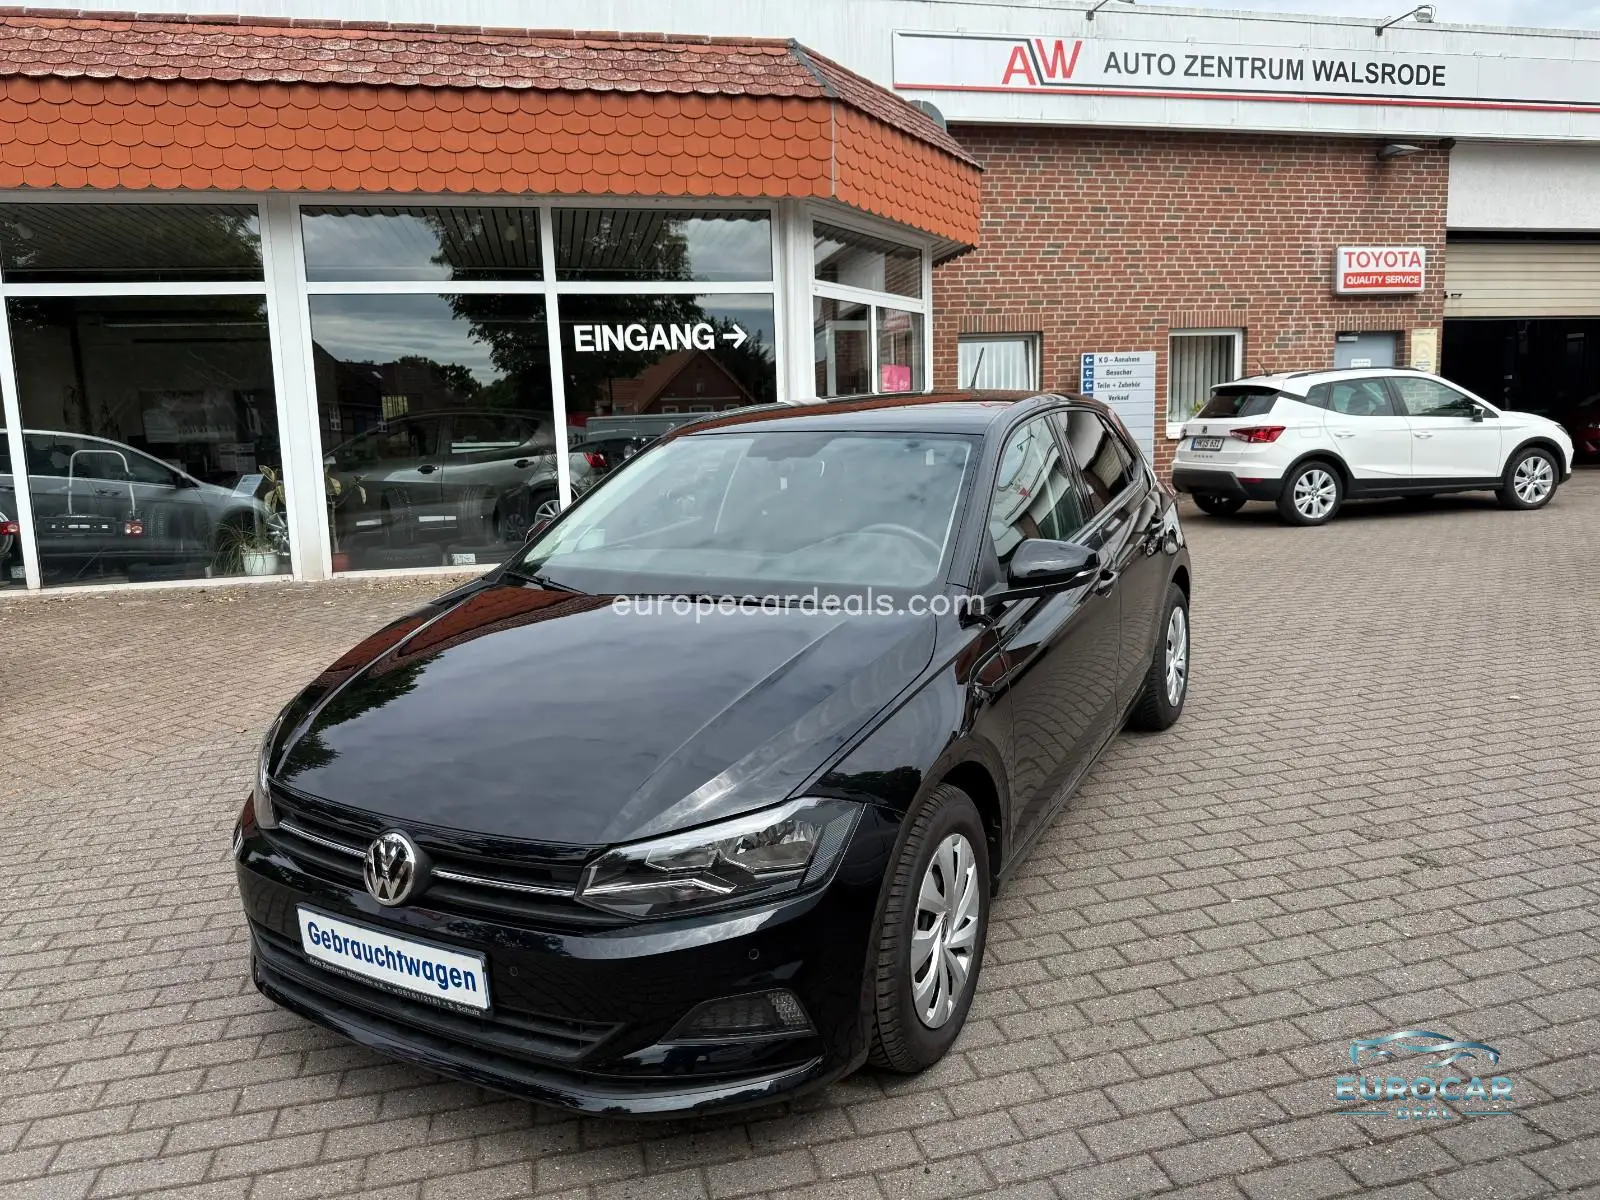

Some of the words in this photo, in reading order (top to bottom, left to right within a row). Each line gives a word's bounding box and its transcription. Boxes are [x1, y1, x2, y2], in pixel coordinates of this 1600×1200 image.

[1104, 51, 1176, 76] AUTO
[1184, 54, 1304, 81] ZENTRUM
[1312, 60, 1446, 87] WALSRODE
[1343, 251, 1421, 268] TOYOTA
[1346, 275, 1383, 285] QUALITY
[1385, 275, 1419, 284] SERVICE
[573, 323, 715, 352] EINGANG
[307, 921, 477, 992] Gebrauchtwagen
